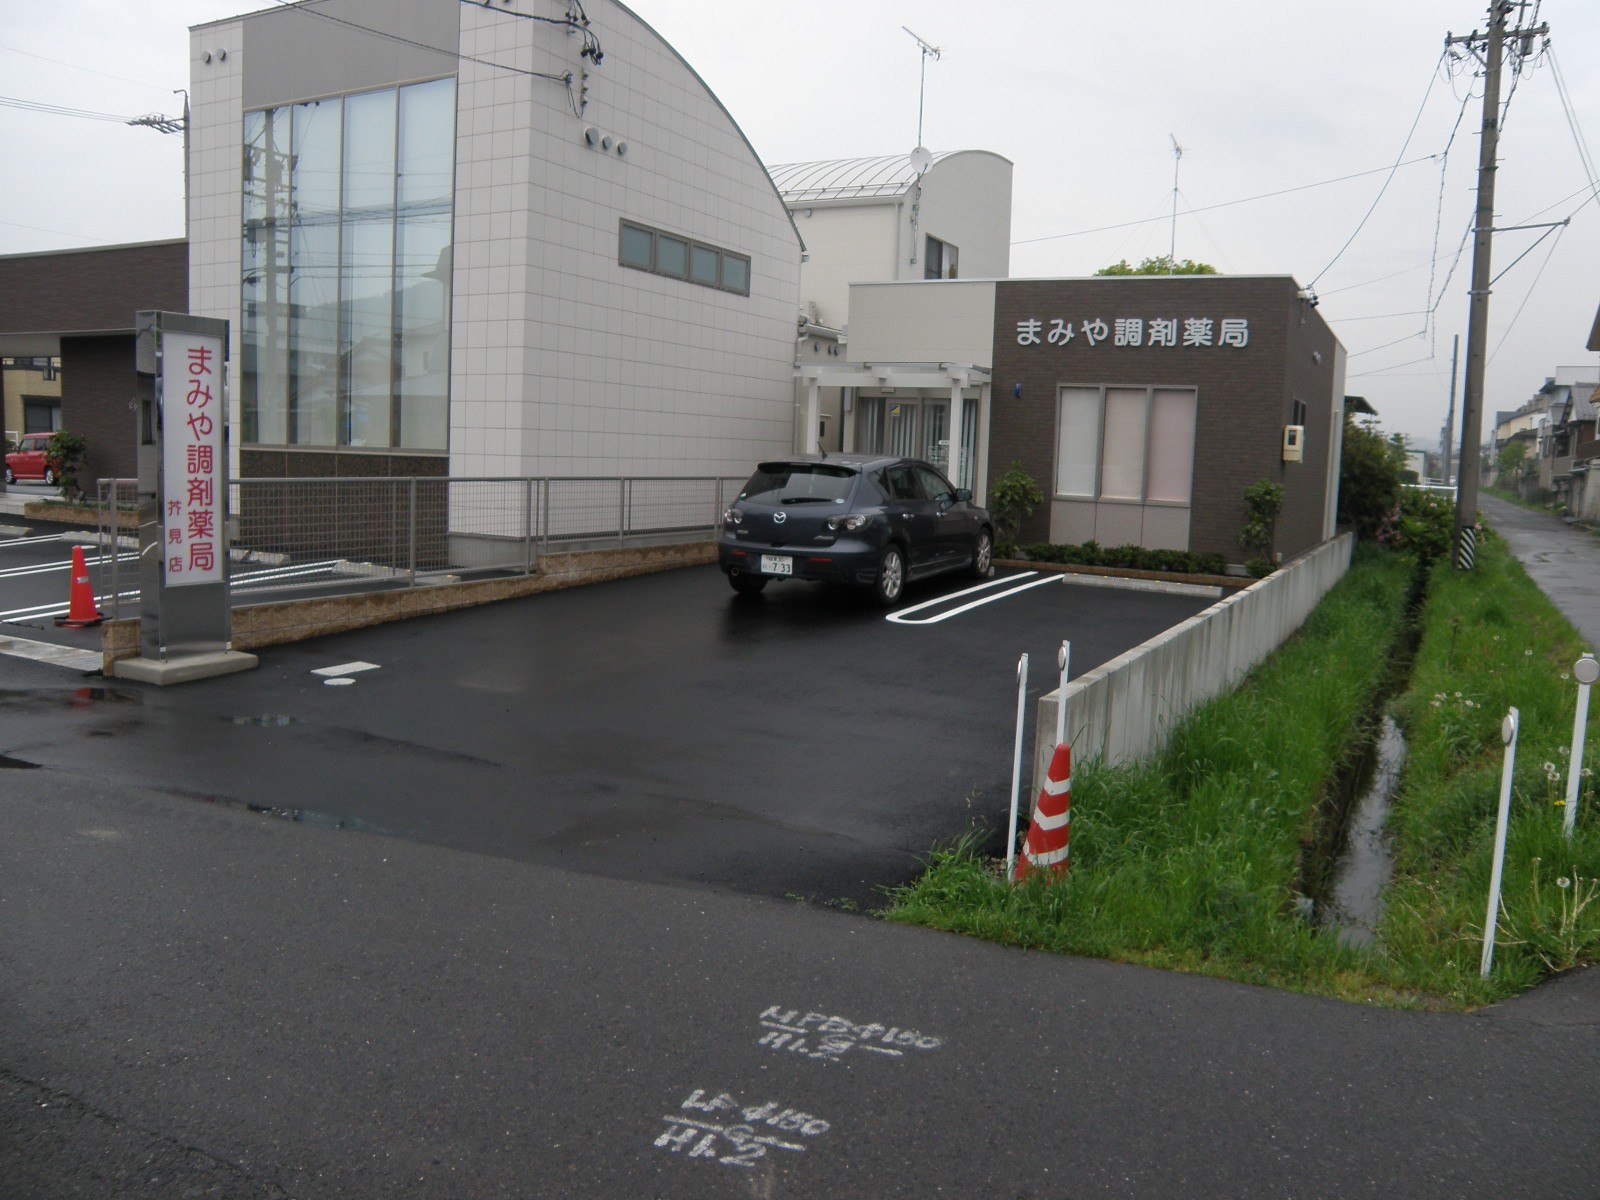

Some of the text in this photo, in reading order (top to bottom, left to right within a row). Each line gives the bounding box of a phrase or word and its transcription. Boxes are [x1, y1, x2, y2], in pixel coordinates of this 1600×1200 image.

[1016, 317, 1249, 348] まみや調剤薬局
[187, 346, 214, 572] まみや調剤薬局
[168, 500, 183, 573] 芥見店
